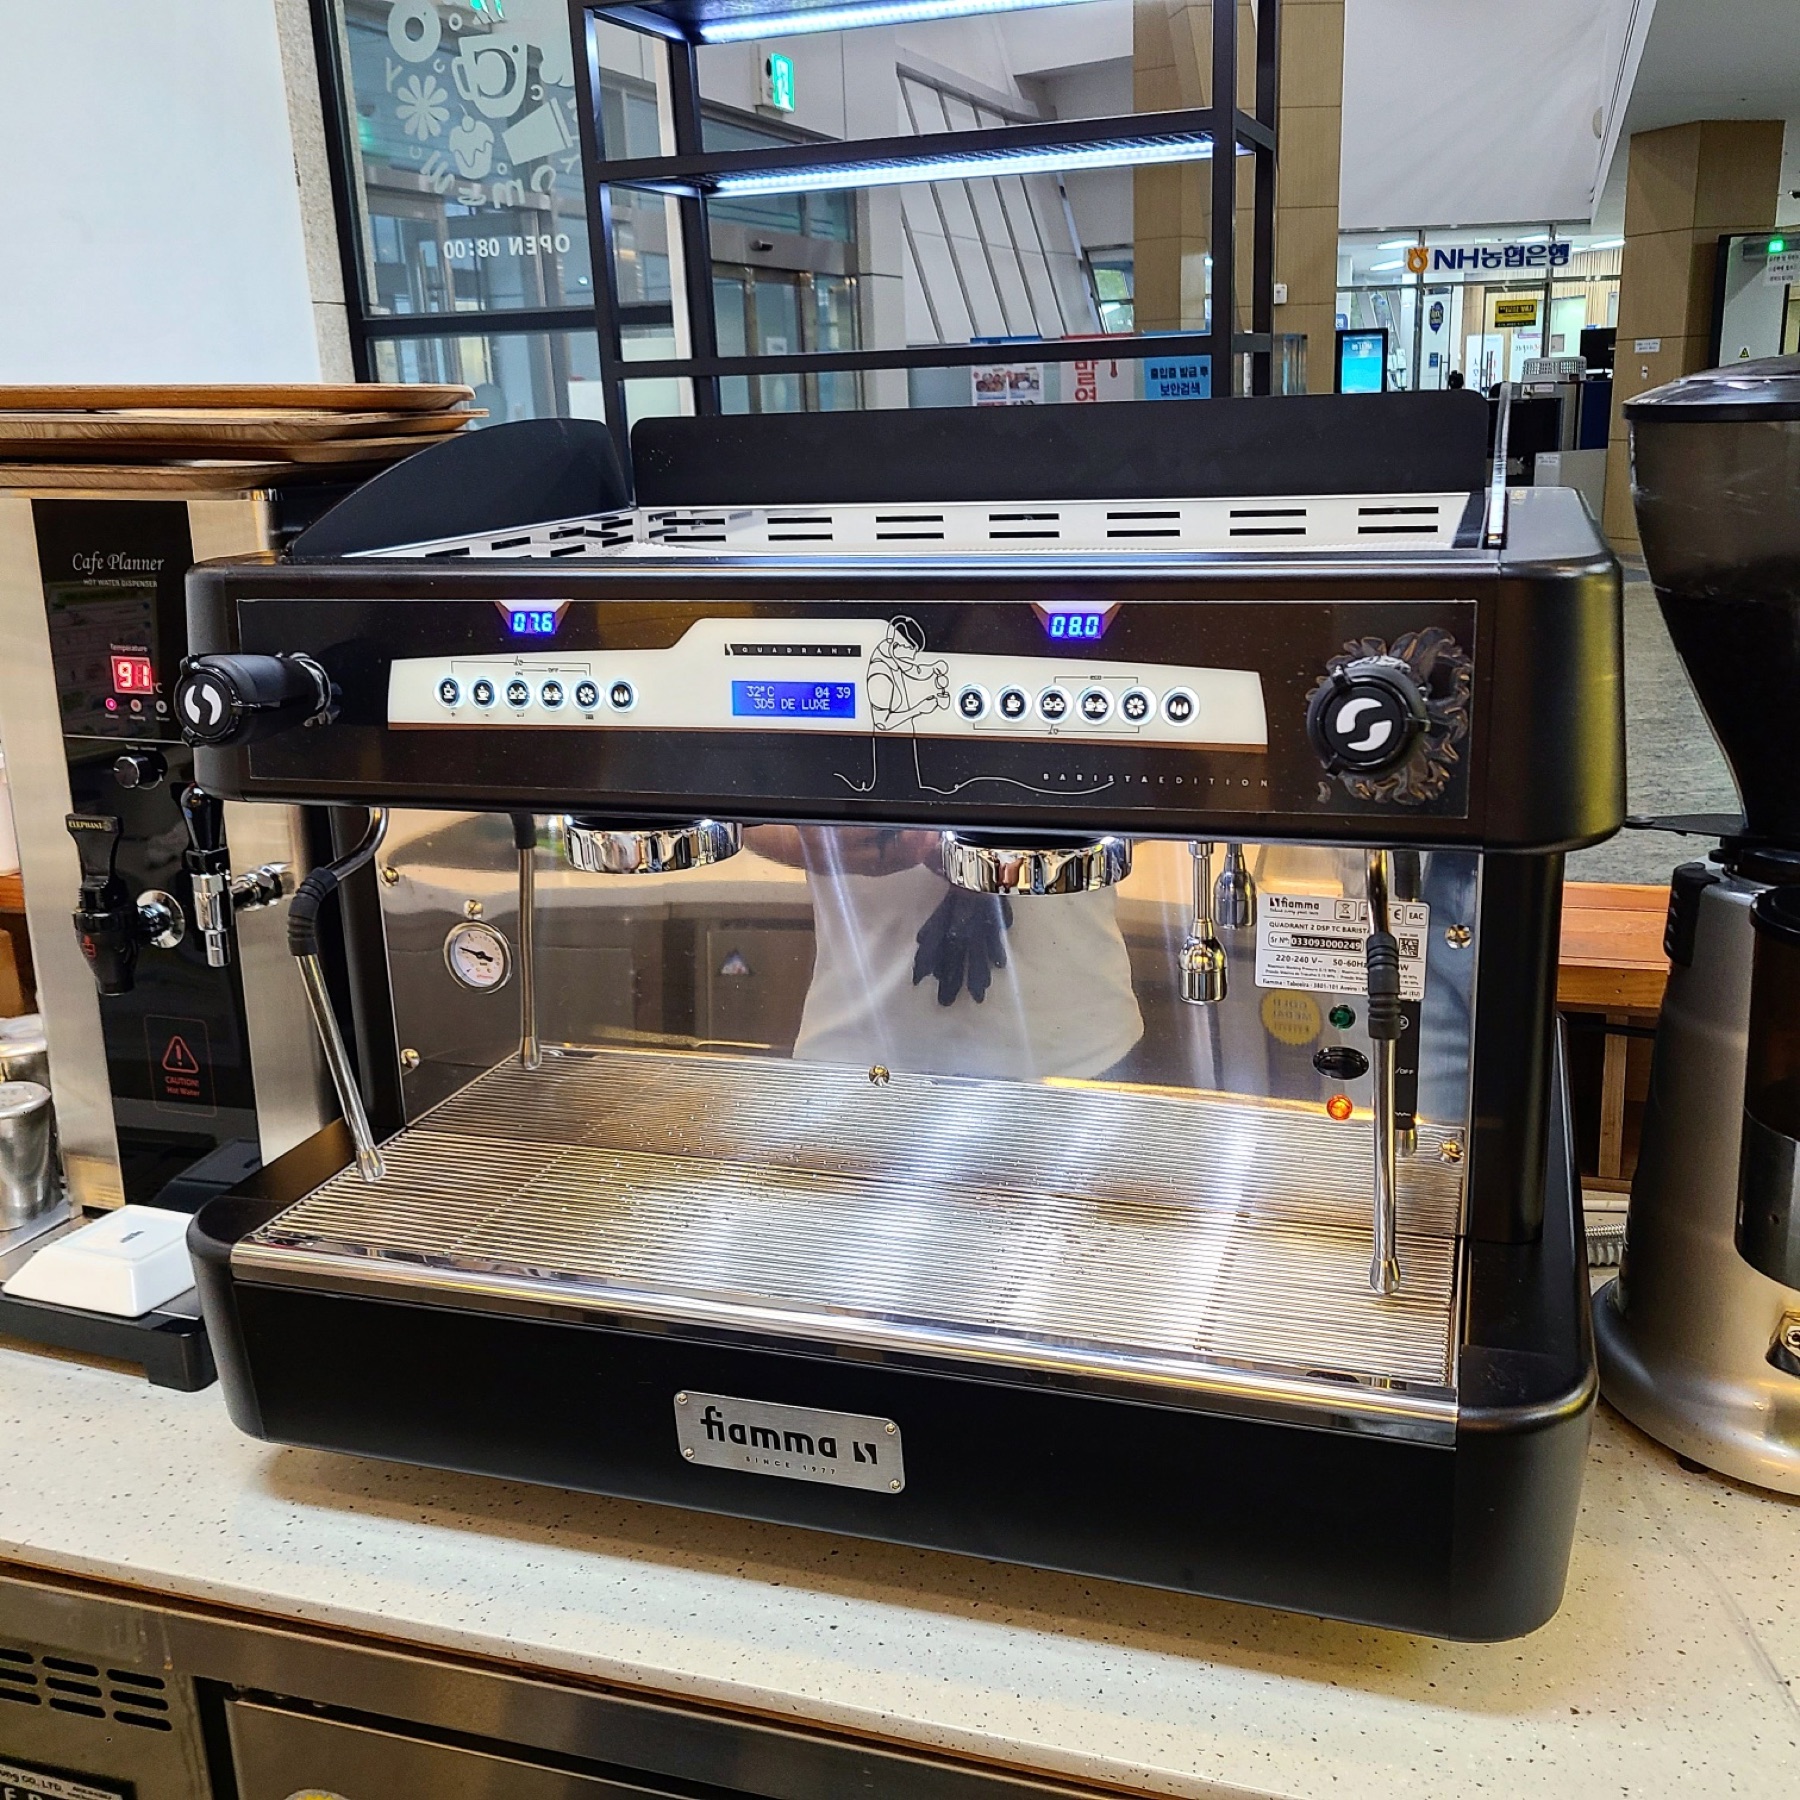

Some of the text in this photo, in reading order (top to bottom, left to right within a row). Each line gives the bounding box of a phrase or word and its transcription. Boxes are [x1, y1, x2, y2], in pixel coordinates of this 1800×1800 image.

[1434, 243, 1570, 270] NH농협은행
[1179, 366, 1198, 379] 발급
[1160, 382, 1201, 397] 보안검색
[72, 551, 165, 575] Cafe Planner
[118, 661, 150, 688] 91
[781, 699, 796, 710] DE
[802, 699, 831, 711] LUXE
[1280, 897, 1320, 910] fiamma
[1408, 912, 1424, 920] EAC
[1269, 922, 1309, 931] QUADRANT
[1275, 955, 1309, 964] 220-240
[700, 1405, 838, 1459] fiamma
[745, 1456, 836, 1475] SINCE 1977
